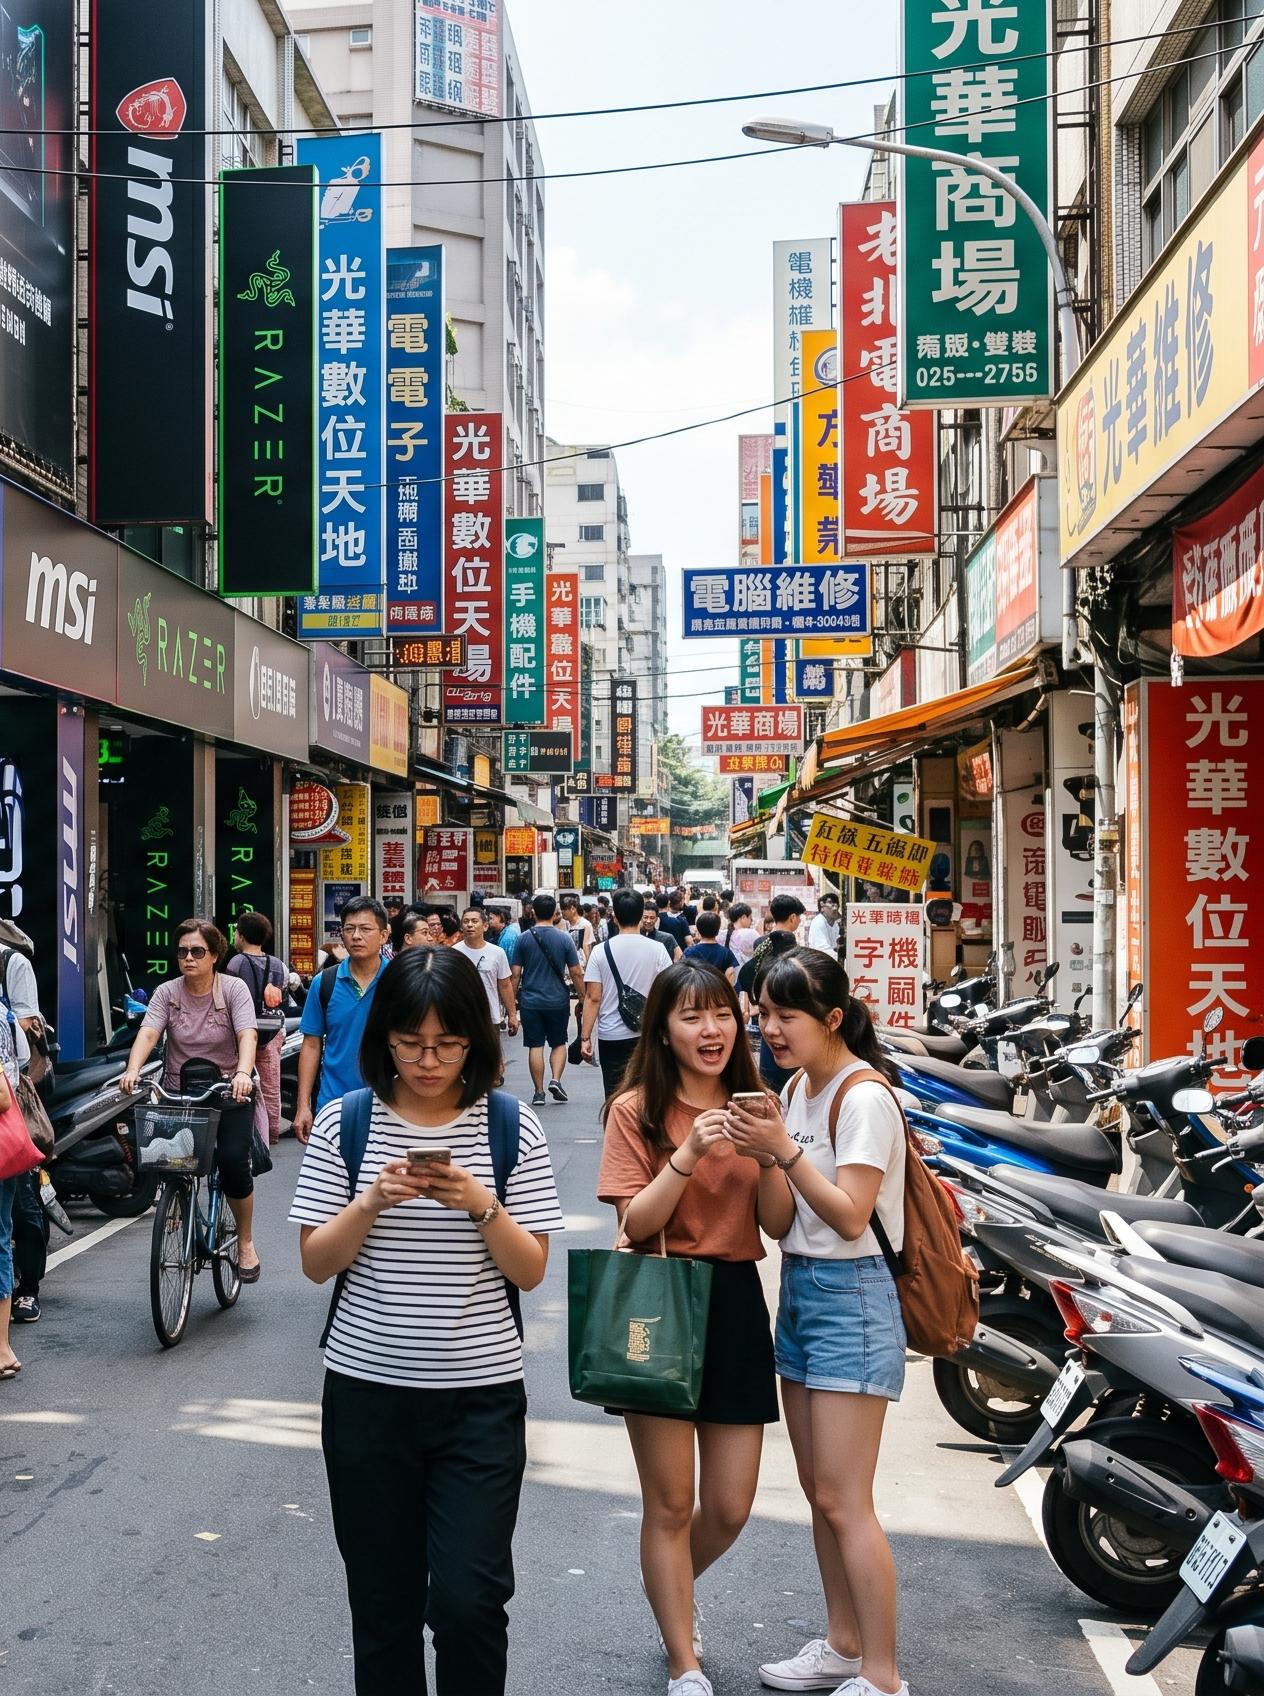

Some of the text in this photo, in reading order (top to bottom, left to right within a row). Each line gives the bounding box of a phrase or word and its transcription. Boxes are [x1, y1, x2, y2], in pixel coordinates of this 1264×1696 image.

[127, 145, 175, 320] msi
[254, 329, 283, 498] RAZER
[321, 254, 367, 567] 光華數位天地
[387, 313, 429, 462] 電電子
[916, 362, 1038, 387] 025---2756
[1102, 240, 1214, 497] 光華維修
[24, 551, 98, 645] msi
[509, 582, 537, 699] 手機配件
[690, 570, 860, 614] 電腦維修
[158, 617, 227, 695] RAZER
[146, 852, 169, 974] RAZER
